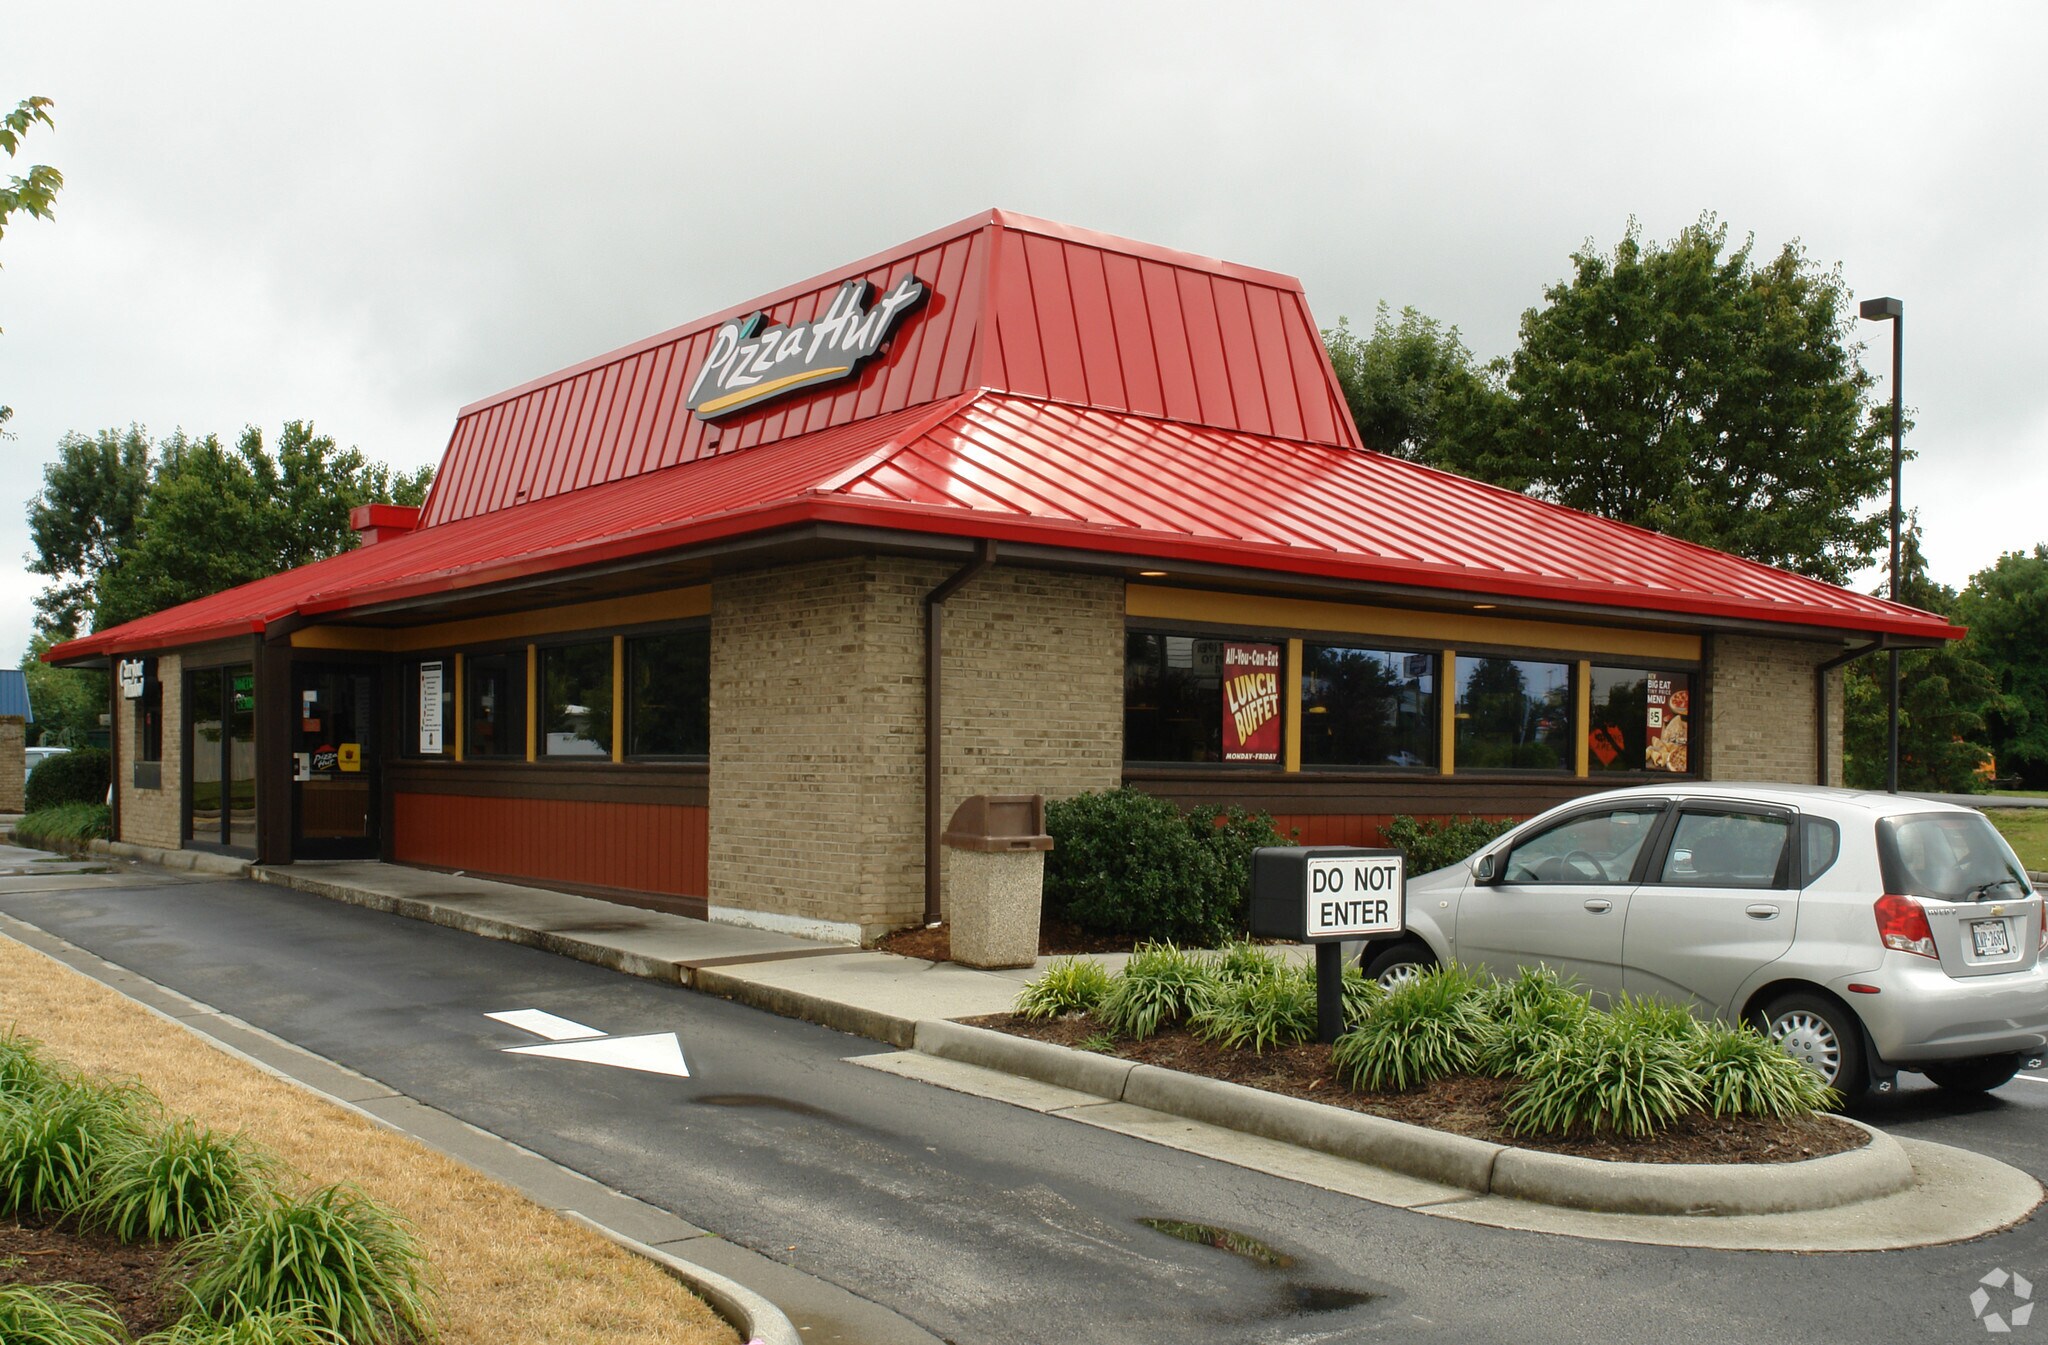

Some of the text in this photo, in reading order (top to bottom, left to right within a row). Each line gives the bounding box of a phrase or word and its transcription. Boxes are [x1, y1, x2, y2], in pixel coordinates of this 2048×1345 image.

[688, 279, 918, 403] Pizza Hut
[1647, 680, 1671, 689] BIG EAT
[1225, 673, 1277, 714] LUNCH
[1647, 694, 1665, 704] MENU
[1234, 693, 1279, 747] BUFFET
[1650, 711, 1660, 723] $5
[313, 752, 338, 765] Pizza
[1225, 752, 1278, 761] MONDAY-FRIDAY
[318, 759, 336, 768] Hut
[1312, 866, 1397, 893] DO NOT
[1320, 899, 1389, 927] ENTER
